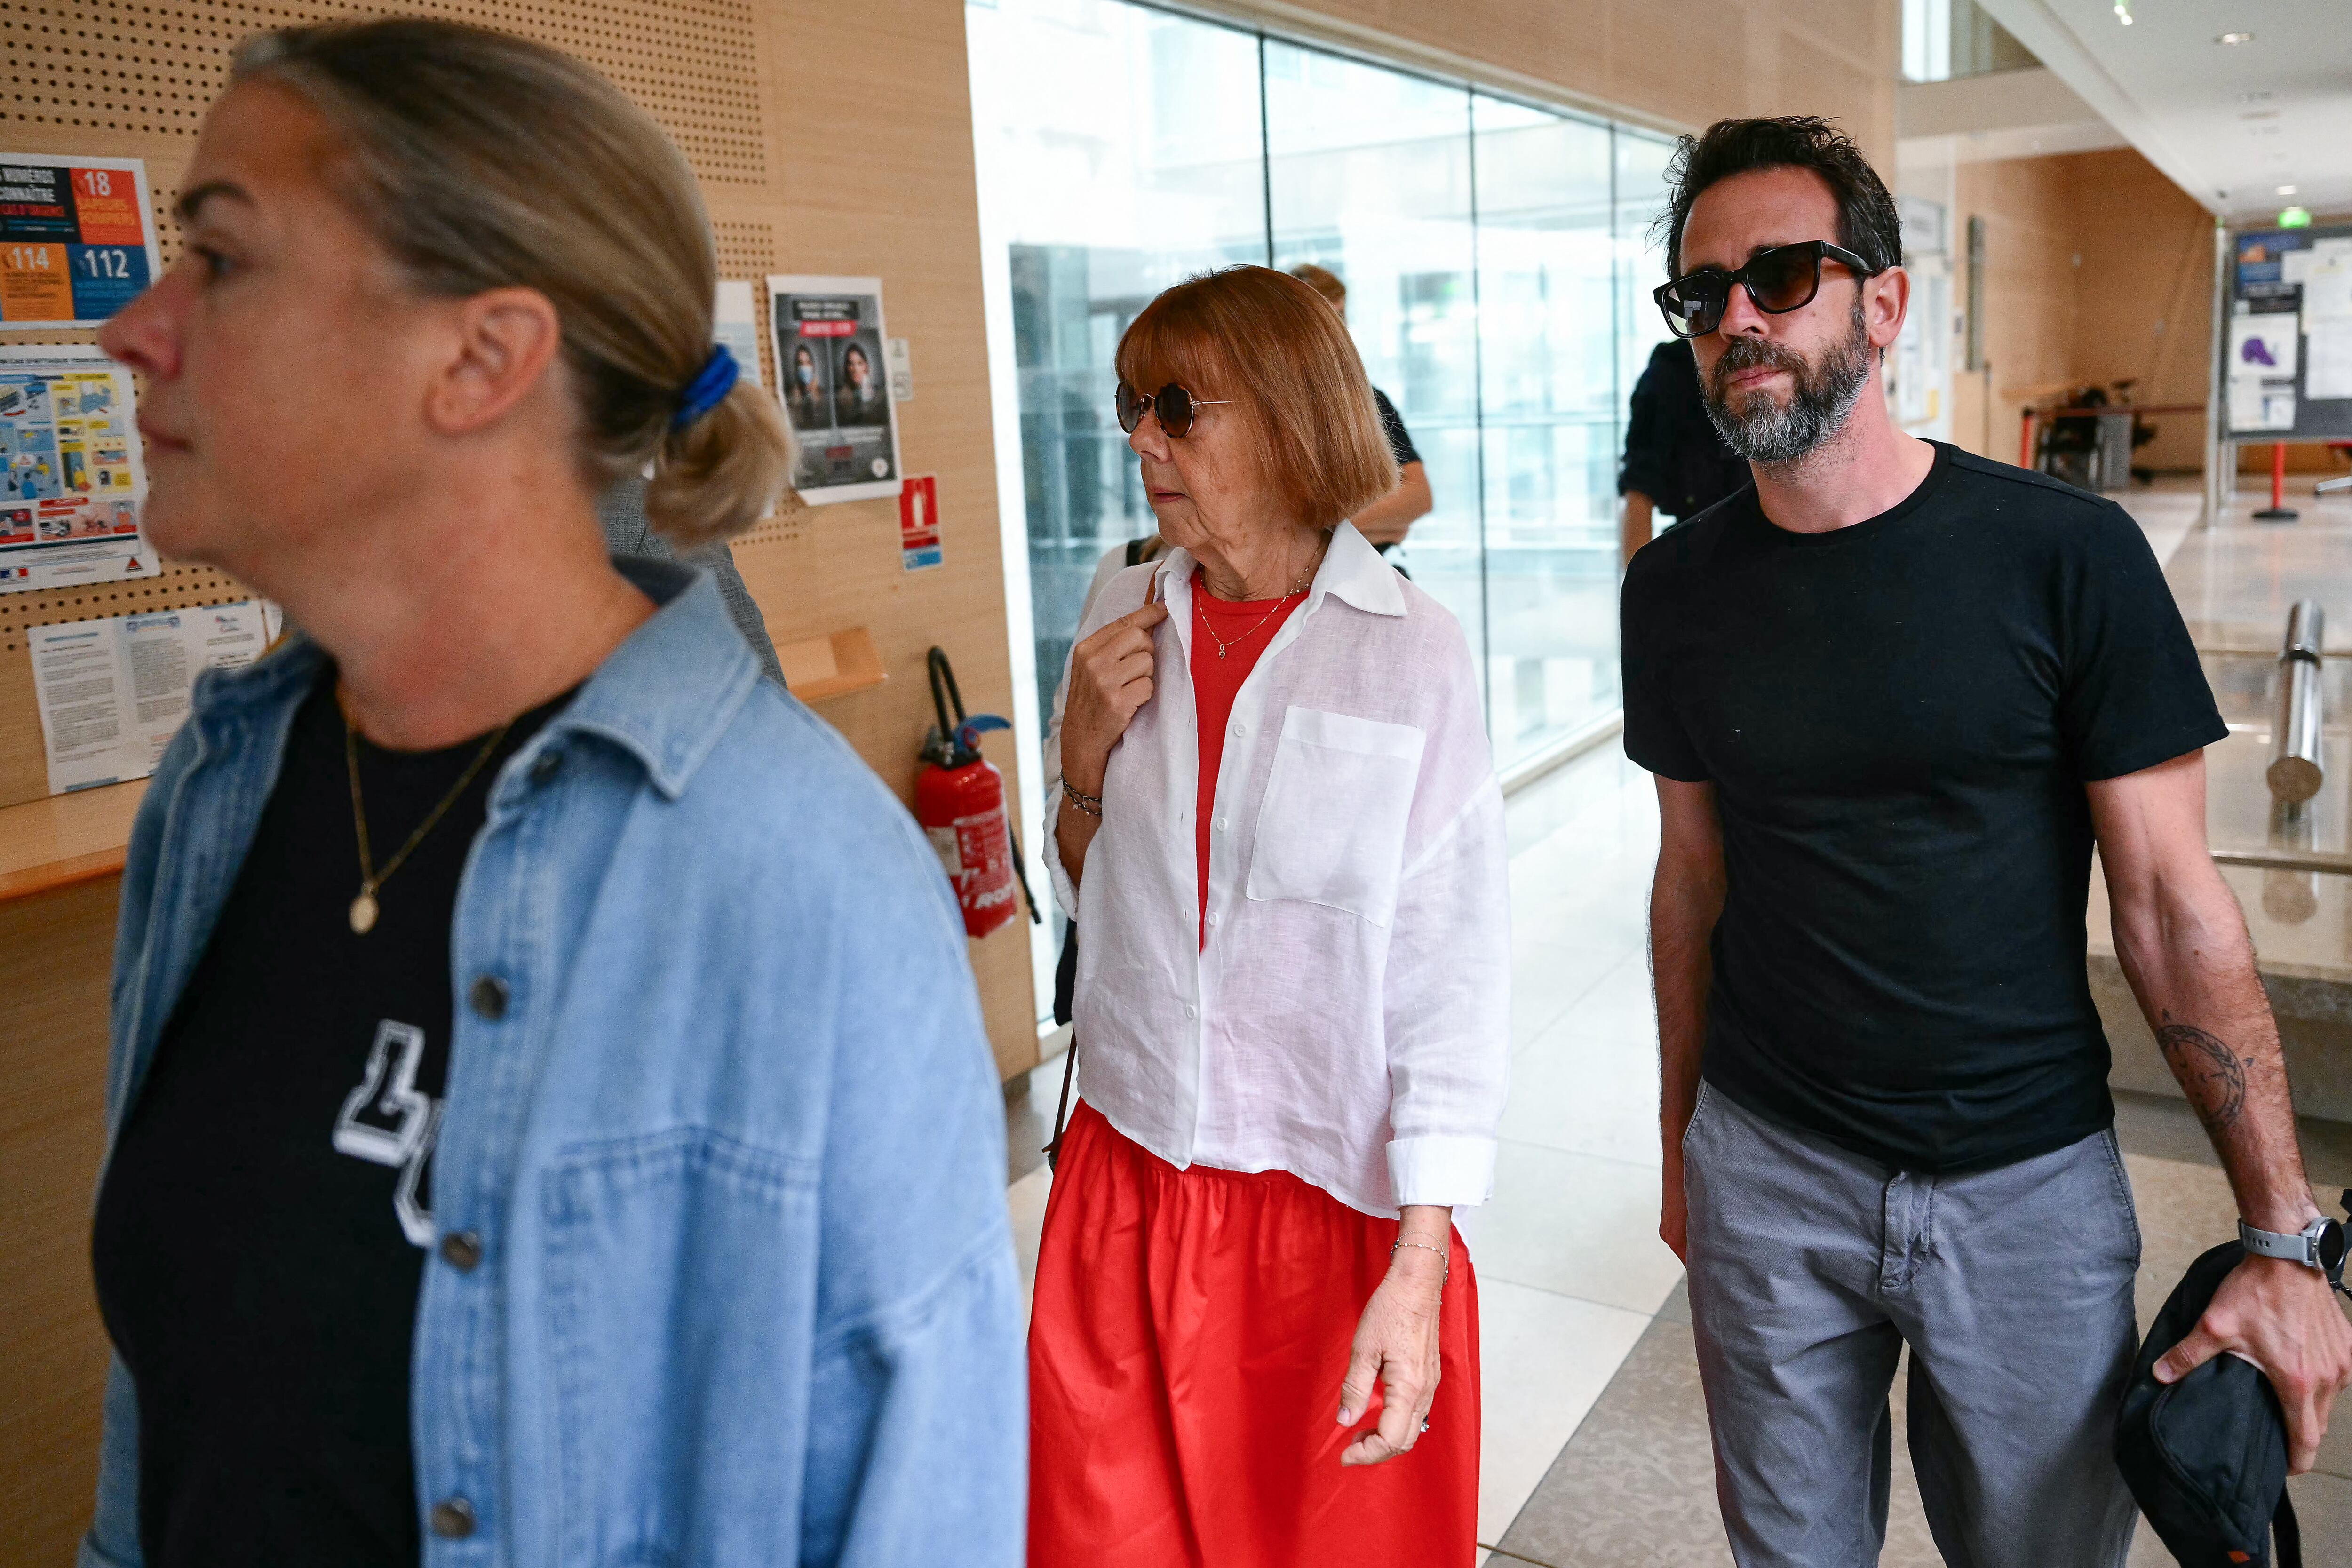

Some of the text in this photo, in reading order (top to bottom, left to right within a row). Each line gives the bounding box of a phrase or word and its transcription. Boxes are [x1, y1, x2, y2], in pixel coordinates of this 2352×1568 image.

[84, 171, 111, 196] 18
[12, 247, 49, 270] 114
[84, 249, 130, 278] 112
